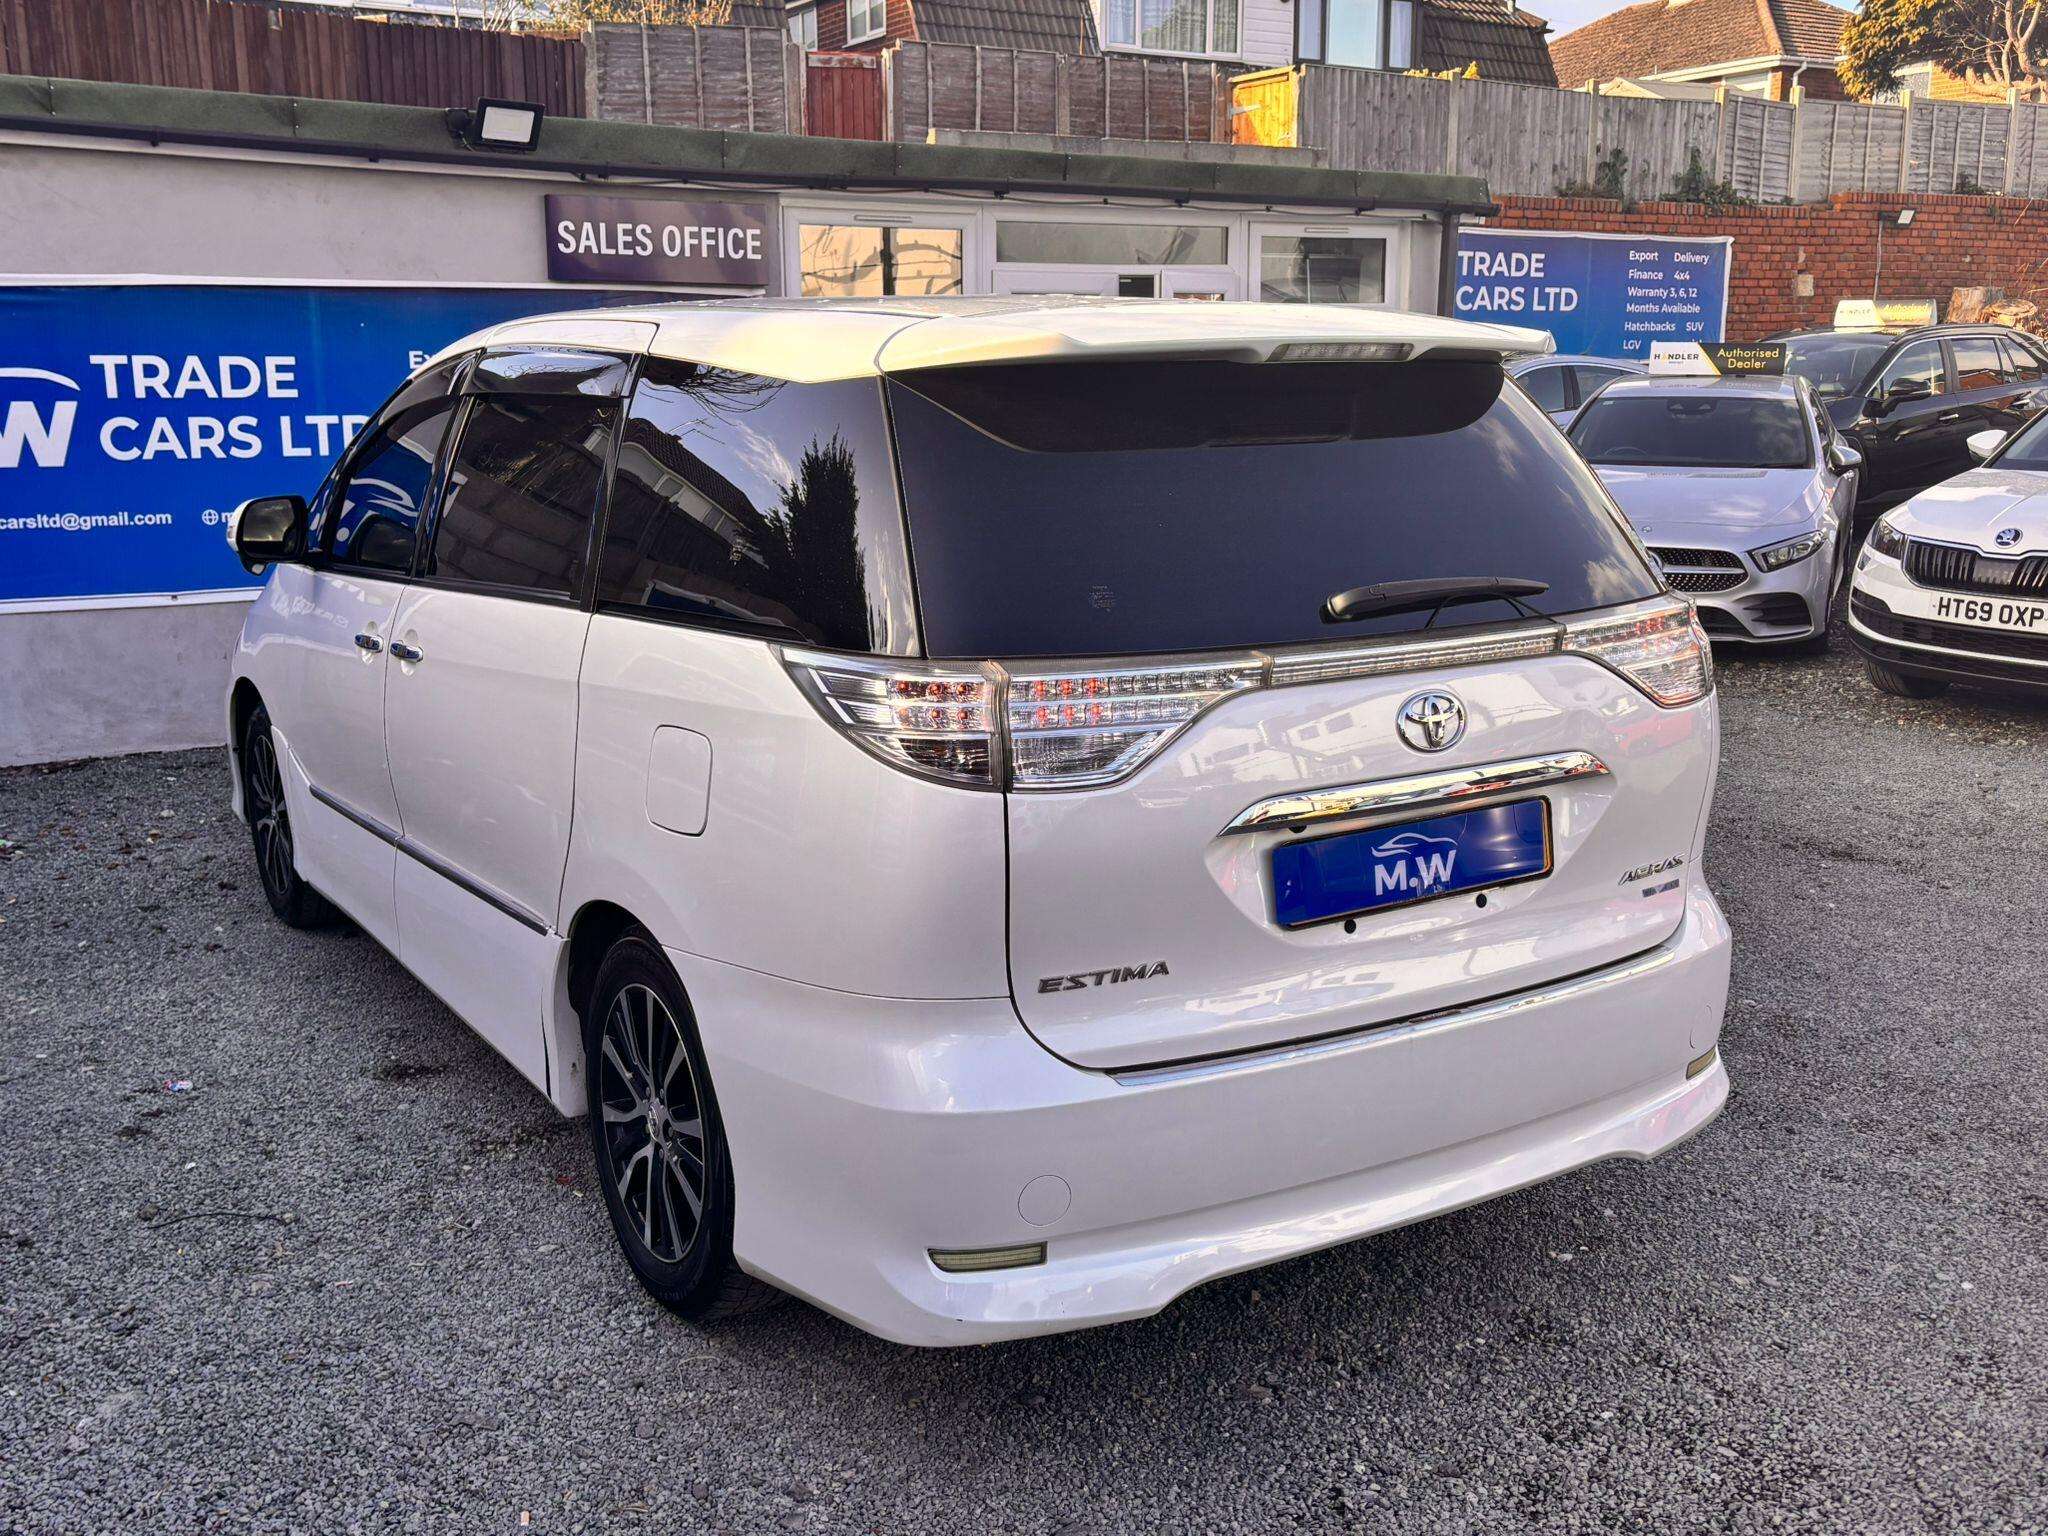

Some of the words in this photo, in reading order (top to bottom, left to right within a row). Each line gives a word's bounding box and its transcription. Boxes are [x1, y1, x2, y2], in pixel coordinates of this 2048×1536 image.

[557, 220, 653, 257] SALES
[662, 225, 762, 260] OFFICE
[1457, 250, 1546, 278] TRADE
[1629, 250, 1659, 263] Export
[1674, 252, 1710, 265] Delivery
[1628, 269, 1664, 280] Finance
[1673, 270, 1690, 280] 4x4
[1455, 285, 1525, 312] CARS
[1532, 286, 1579, 312] LTD
[1627, 286, 1668, 299] Warranty
[1669, 287, 1678, 298] 3,
[1679, 287, 1687, 298] 6,
[1688, 287, 1698, 298] 12
[1626, 302, 1660, 313] Months
[1661, 303, 1701, 314] Available
[1624, 321, 1676, 332] Hatchbacks
[1685, 321, 1704, 332] SUV
[1623, 340, 1641, 350] LGV
[1717, 347, 1780, 358] Authorised
[1727, 359, 1766, 369] Dealer
[89, 354, 299, 399] TRADE
[99, 415, 263, 462] CARS
[1937, 596, 1993, 622] HT69
[1998, 604, 2045, 627] OXP
[1037, 959, 1170, 994] ESTIMA
